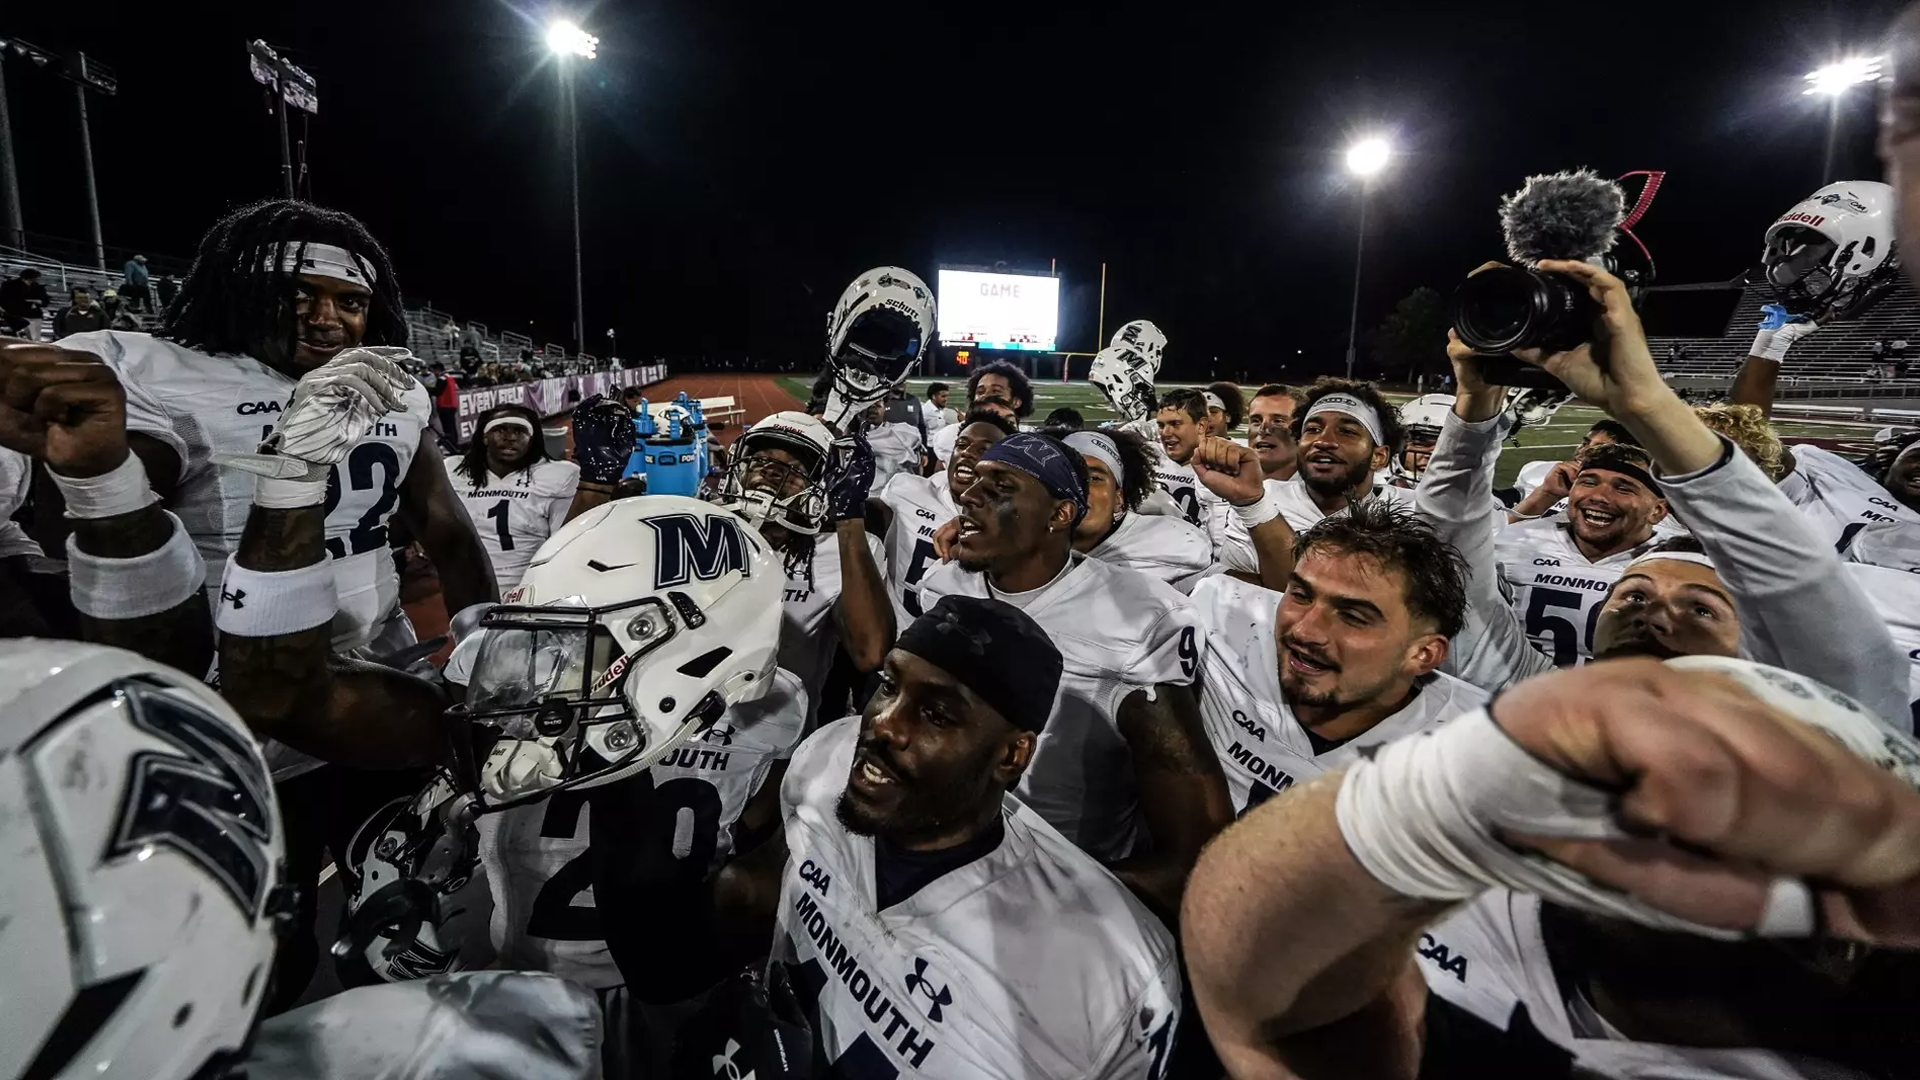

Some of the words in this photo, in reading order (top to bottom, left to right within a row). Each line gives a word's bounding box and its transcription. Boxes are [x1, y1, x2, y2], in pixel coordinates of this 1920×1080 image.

[980, 283, 1020, 298] GAME
[885, 298, 919, 319] schutt
[1120, 325, 1142, 346] M
[1116, 349, 1148, 370] M
[236, 401, 282, 415] CAA
[459, 389, 497, 416] EVERY
[1154, 472, 1195, 485] ONMOU
[467, 489, 529, 499] MONMOUTH
[1868, 496, 1899, 512] CAA
[487, 499, 515, 551] 1
[915, 508, 936, 521] CAA
[641, 513, 750, 591] M
[1533, 558, 1560, 567] CAA
[1534, 573, 1609, 592] MONMO
[1178, 626, 1199, 678] 9
[1232, 710, 1266, 743] CAA
[658, 748, 730, 771] OUTH
[1227, 741, 1295, 791] MONM
[799, 859, 832, 897] CAA
[1417, 932, 1468, 984] CAA
[795, 891, 935, 1069] MONMOUTH
